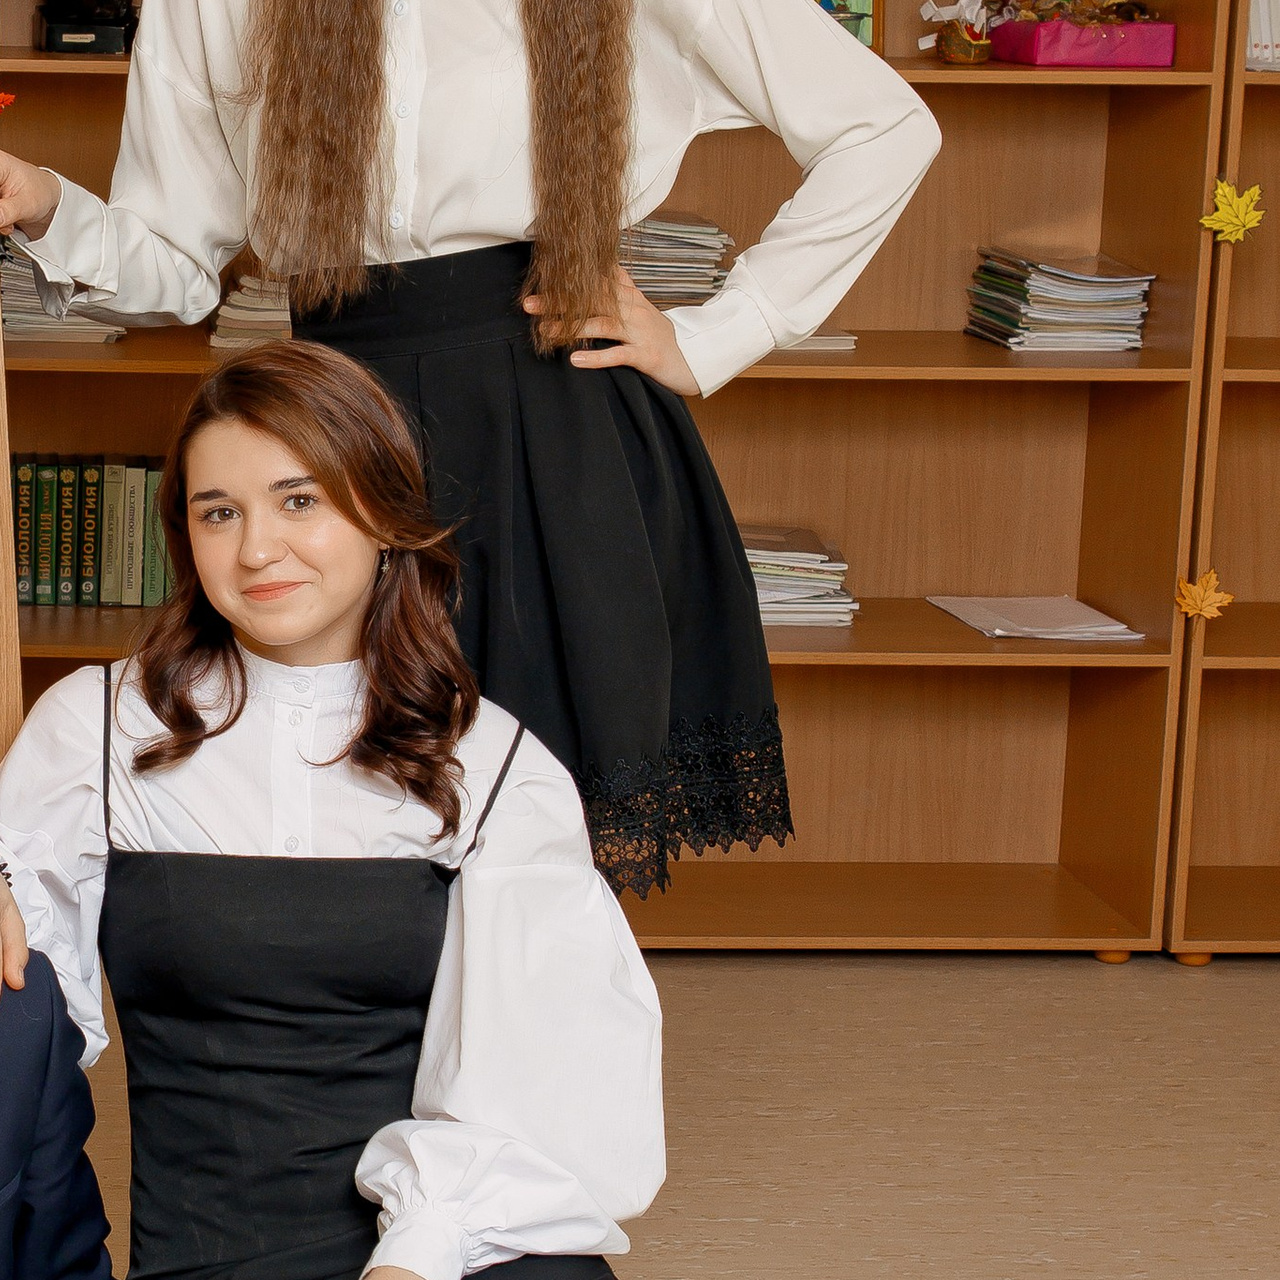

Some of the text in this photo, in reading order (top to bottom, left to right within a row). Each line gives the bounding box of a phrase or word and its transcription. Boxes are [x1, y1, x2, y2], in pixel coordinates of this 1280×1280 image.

[19, 485, 30, 577] БИОЛОГИЯ
[61, 487, 73, 577] БИОЛОГИЯ
[83, 486, 97, 577] БИОЛОГИЯ
[128, 485, 136, 538] СООБЩЕСТВА
[39, 513, 52, 580] БИОЛОГИЯ
[19, 582, 28, 591] 2
[62, 582, 71, 592] 4
[83, 582, 92, 592] 5
